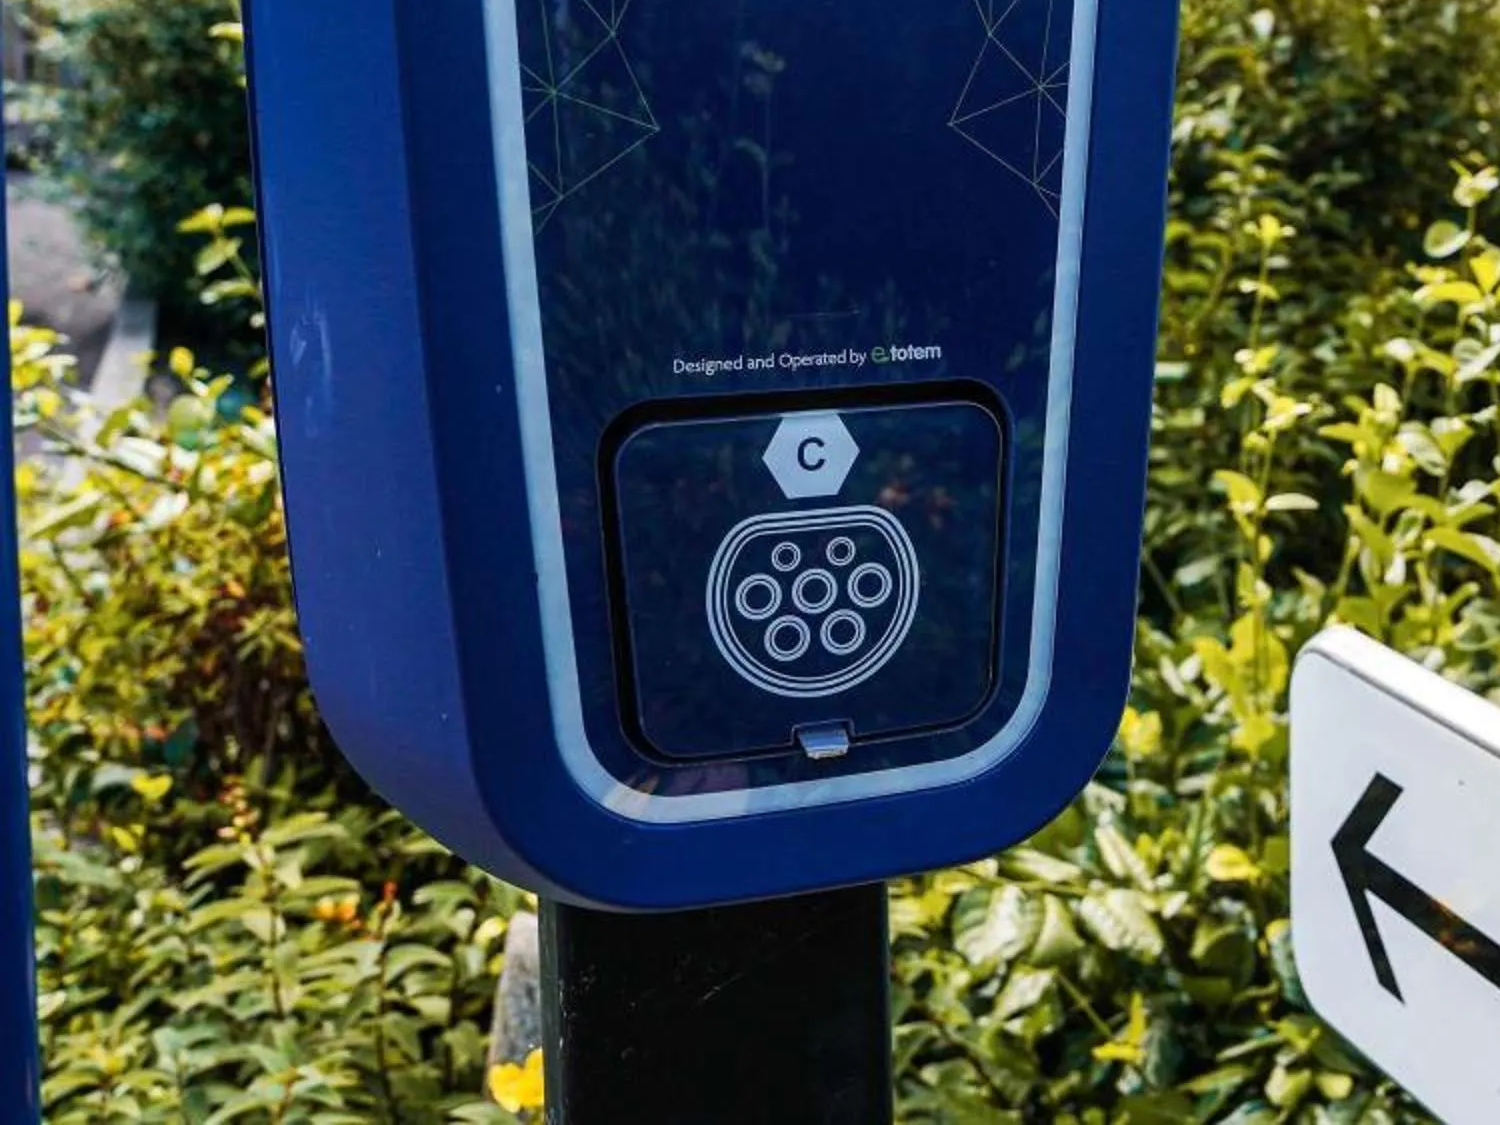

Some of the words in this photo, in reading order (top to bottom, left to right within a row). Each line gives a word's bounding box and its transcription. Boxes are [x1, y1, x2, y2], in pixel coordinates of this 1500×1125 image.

[672, 357, 743, 376] Designed
[746, 353, 775, 370] and
[779, 349, 847, 372] Operated
[849, 349, 867, 367] by
[796, 436, 826, 472] C
